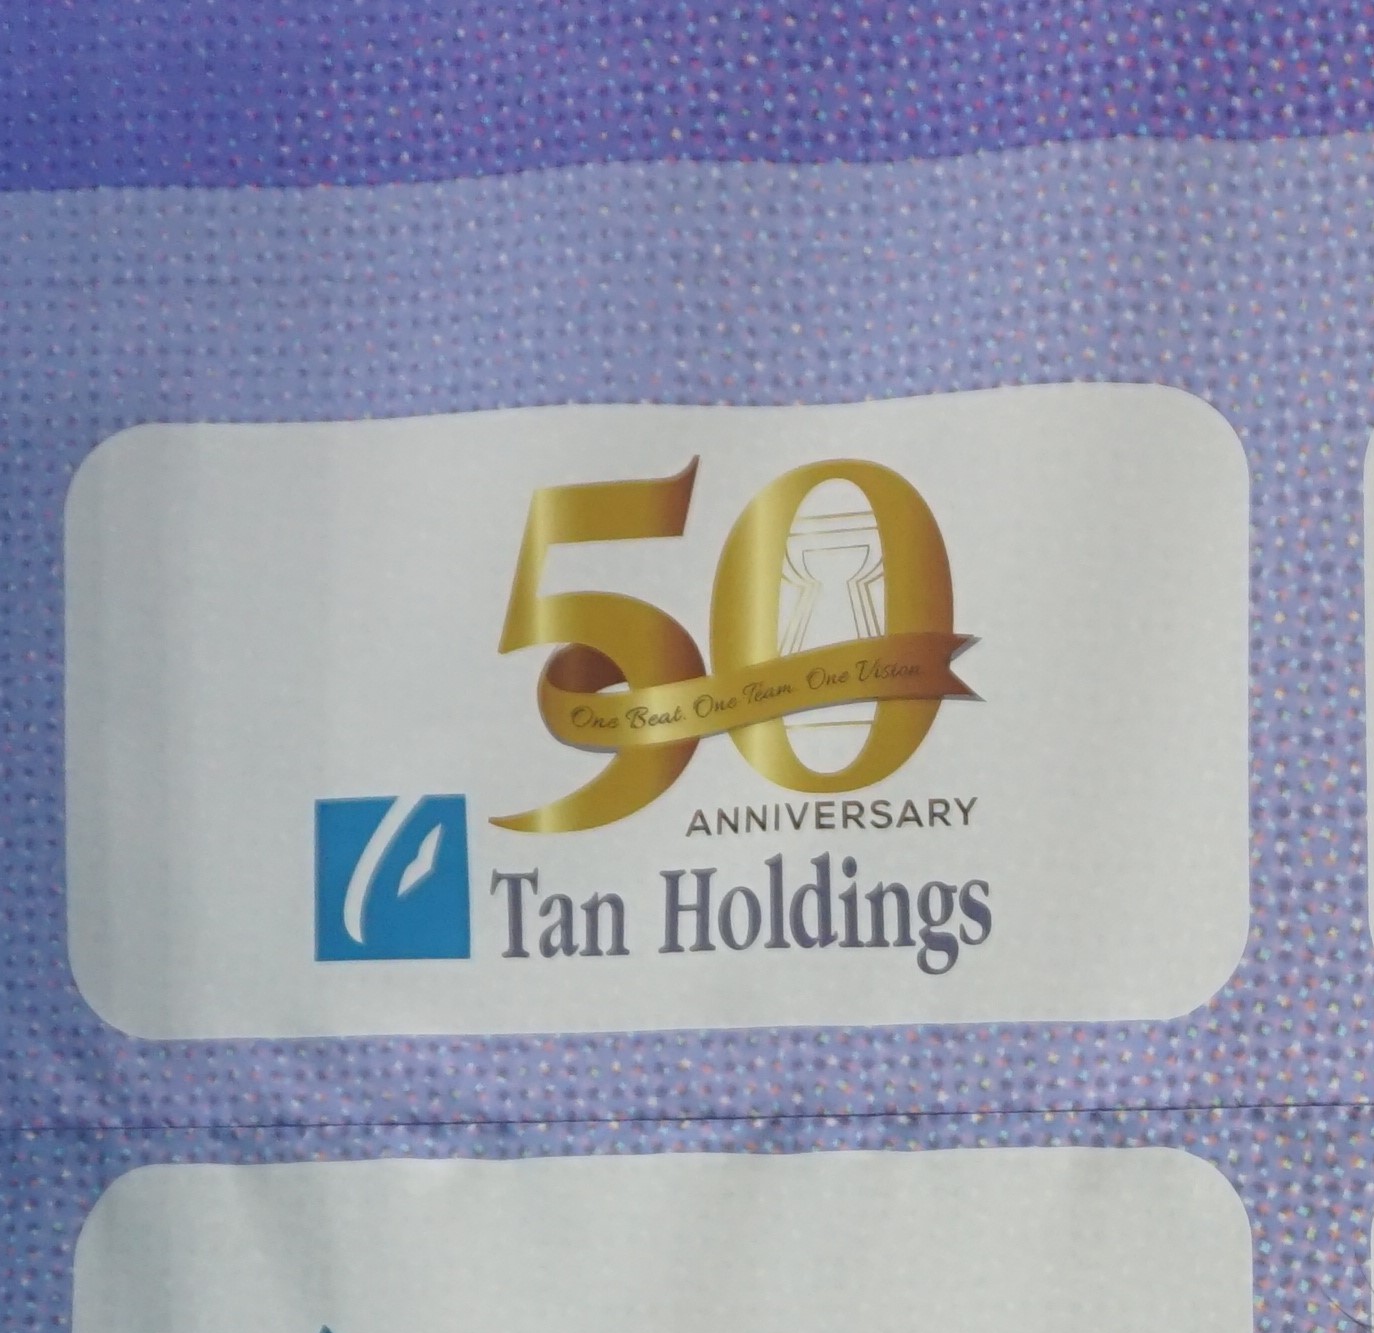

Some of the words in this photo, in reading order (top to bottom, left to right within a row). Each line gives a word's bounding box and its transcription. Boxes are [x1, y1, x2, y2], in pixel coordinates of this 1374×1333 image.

[488, 454, 955, 834] 50
[571, 704, 619, 729] One
[693, 694, 738, 719] One
[806, 666, 849, 691] One
[686, 797, 978, 838] ANNIVERSARY
[491, 868, 629, 959] Tan
[659, 852, 993, 975] Holdings
